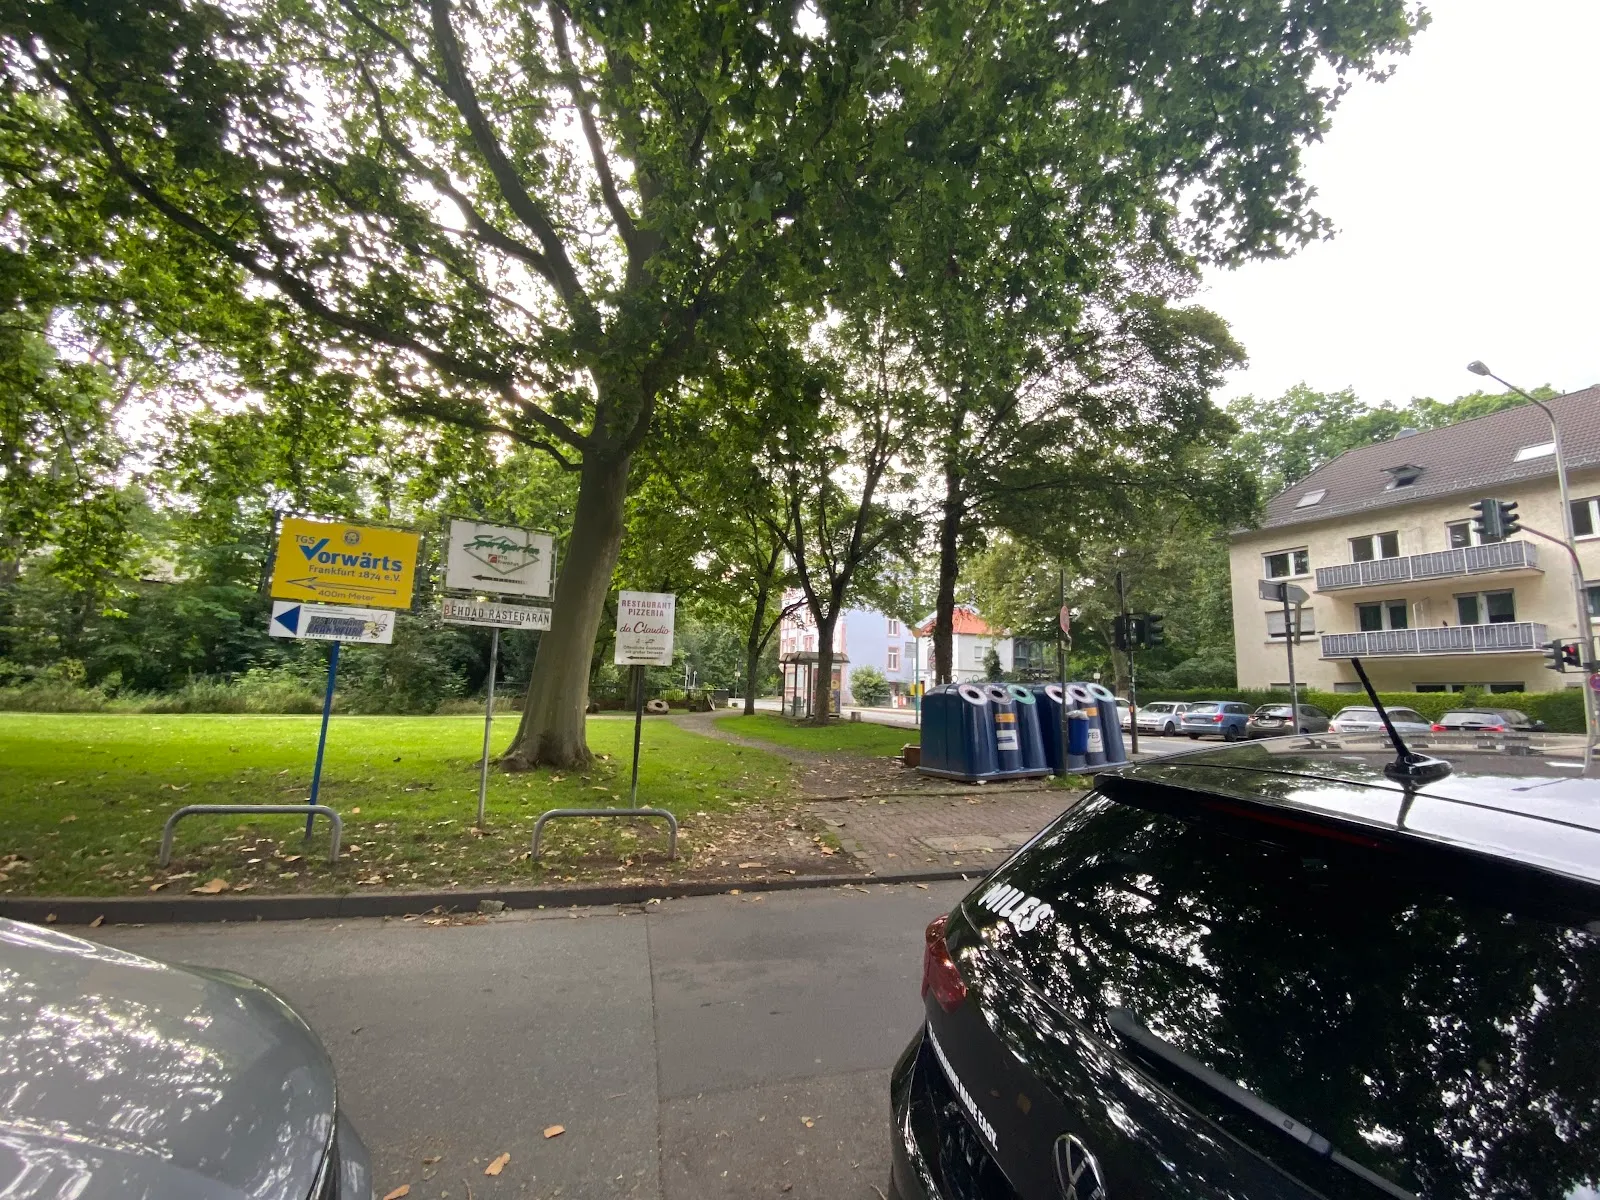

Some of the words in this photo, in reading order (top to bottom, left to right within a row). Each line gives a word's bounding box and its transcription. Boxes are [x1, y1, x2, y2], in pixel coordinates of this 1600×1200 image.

[294, 535, 315, 545] TGS
[299, 538, 402, 572] Vorwärts
[308, 564, 355, 577] Frankfurt
[359, 571, 381, 582] 1874
[384, 574, 401, 583] e.V.
[318, 590, 346, 599] 400m
[348, 592, 375, 602] Meter
[621, 600, 672, 609] RESTAURANT
[444, 604, 484, 618] BEHDAD
[489, 609, 550, 624] RASTEGARAN
[628, 608, 664, 617] PIZZERIA
[620, 623, 631, 633] da
[633, 621, 670, 635] Claudio
[977, 882, 1052, 932] MILES
